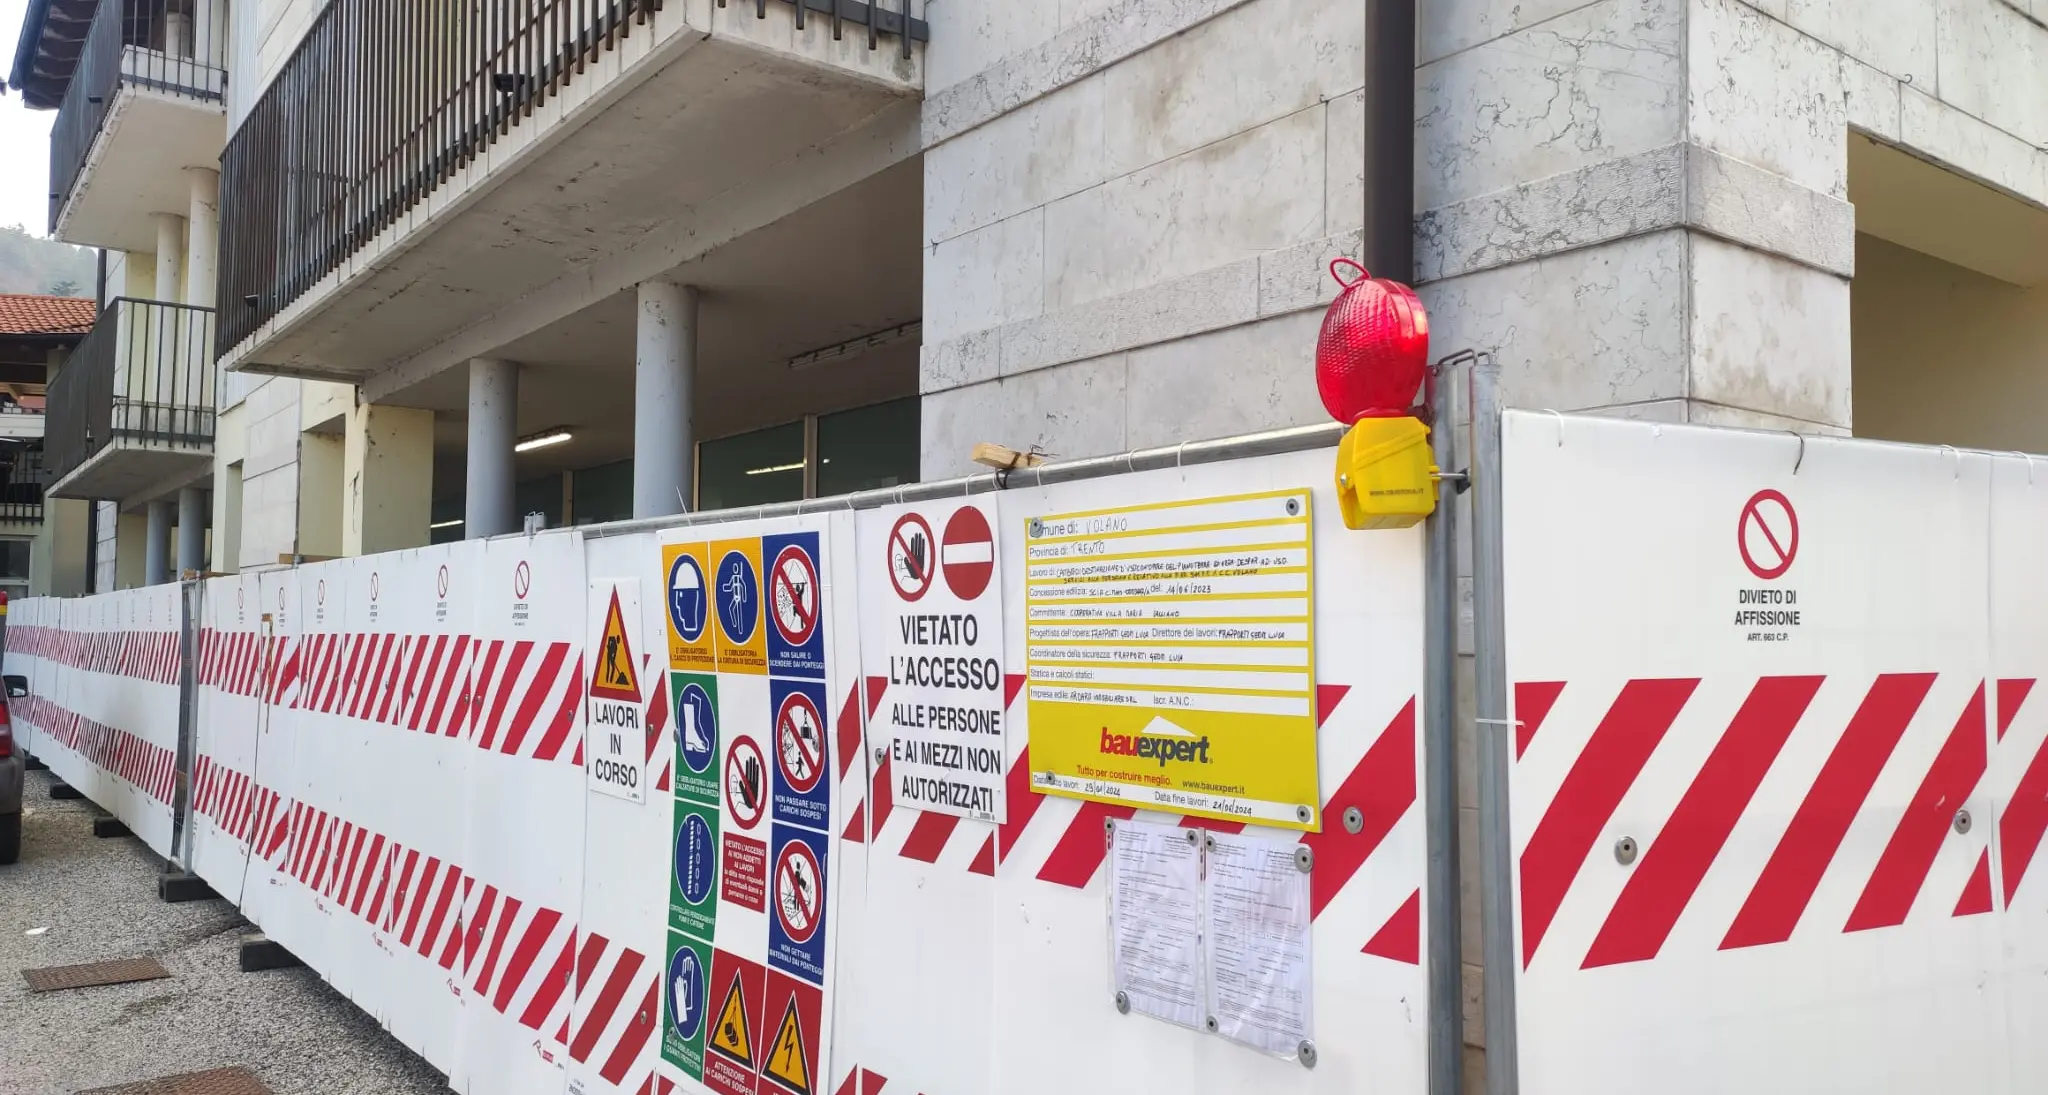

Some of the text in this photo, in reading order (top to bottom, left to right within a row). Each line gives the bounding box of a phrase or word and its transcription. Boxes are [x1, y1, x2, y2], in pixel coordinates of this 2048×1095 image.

[1067, 522, 1078, 534] di:
[1086, 516, 1128, 535] VOLANO
[1029, 546, 1059, 558] Provincia
[1070, 539, 1105, 554] TRENTO
[1029, 569, 1047, 578] Lavoro
[1029, 587, 1064, 598] Concessione
[1066, 586, 1086, 597] edilizia:
[1739, 589, 1797, 604] DIVIETO DI
[1734, 610, 1801, 626] AFFISSIONE
[899, 613, 978, 647] VIETATO
[1029, 627, 1059, 639] Progettista
[1152, 627, 1181, 638] Direttore
[1183, 627, 1194, 638] dei
[1196, 627, 1218, 638] lavori:
[1218, 627, 1249, 639] FRAPPORTI
[1746, 633, 1763, 642] ART.
[1776, 633, 1790, 642] C.P.
[791, 651, 806, 659] SALIRE
[1029, 648, 1066, 659] Coordinatore
[1067, 648, 1081, 658] della
[1082, 648, 1110, 659] sicurezza:
[1113, 651, 1147, 660] FRAPPORTI
[890, 655, 1000, 691] L'ACCESSO
[1030, 668, 1050, 678] Statica
[1056, 669, 1073, 679] calcoli
[1075, 669, 1094, 680] statici:
[1031, 688, 1053, 700] Impresa
[595, 702, 639, 729] LAVORI
[892, 702, 1001, 736] ALLE PERSONE
[610, 732, 621, 756] IN
[1100, 726, 1210, 767] bauexpert
[893, 737, 1001, 776] E AI MEZZI NON
[595, 757, 638, 788] CORSO
[1076, 764, 1245, 794] Tutto per costruire meglio. www.bauexpert.it
[775, 794, 827, 812] NON PASSARE SOTTO
[901, 774, 993, 813] AUTORIZZATI
[1154, 790, 1171, 802] Data
[1172, 794, 1186, 804] fine
[1187, 796, 1209, 808] lavori:
[780, 804, 822, 820] CARICHI SOSPESI
[725, 839, 765, 857] VIETATO L'ACCESSO
[739, 862, 755, 873] LAVORI
[780, 943, 811, 962] NON GETTARE
[791, 957, 800, 967] DAI
[800, 960, 823, 976] PONTEGGI
[705, 1066, 711, 1076] AI
[711, 1069, 731, 1088] CARICHI
[714, 1061, 746, 1083] ATTENZIONE
